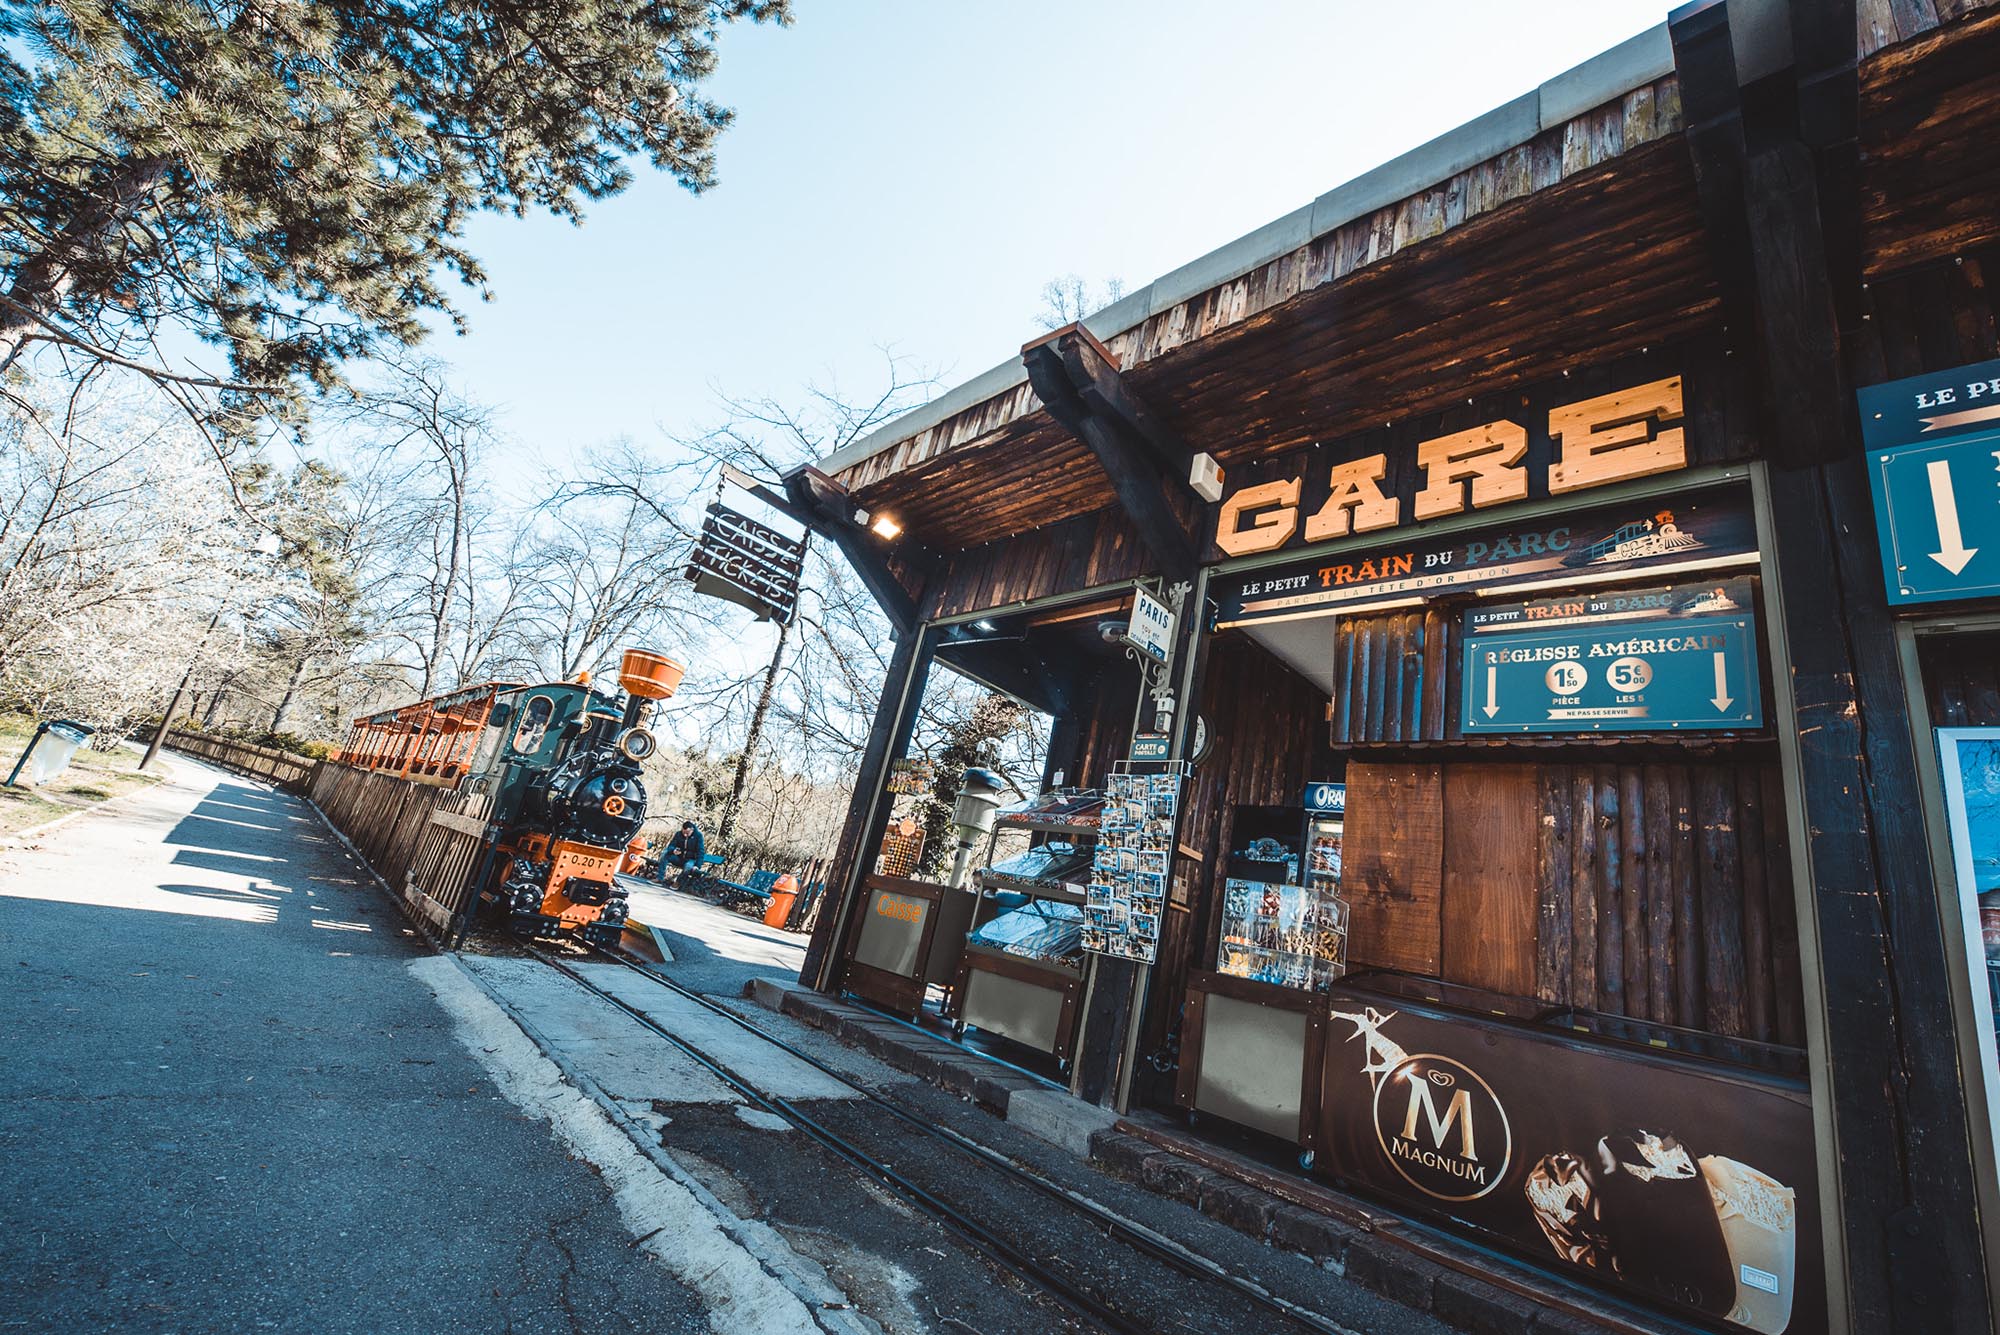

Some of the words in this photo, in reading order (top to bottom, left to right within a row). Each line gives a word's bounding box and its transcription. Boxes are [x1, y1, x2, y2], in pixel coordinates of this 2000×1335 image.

[1915, 388, 1956, 409] LE
[1216, 374, 1687, 557] GARE
[1241, 580, 1261, 597] LE
[1264, 574, 1310, 593] PETIT
[1317, 553, 1415, 587] TRAIN
[1425, 549, 1453, 569] DU
[1464, 527, 1571, 566] PARC
[1277, 595, 1310, 607] PARC
[1318, 592, 1334, 602] DE
[1343, 589, 1359, 598] LA
[1369, 581, 1406, 594] TÊTE
[1416, 575, 1456, 588] D'OR
[1466, 566, 1511, 580] LYON
[1139, 597, 1169, 629] PARIS
[1474, 615, 1487, 623] LE
[1489, 611, 1520, 621] PETIT
[1525, 602, 1585, 620] TRAIN
[1591, 603, 1608, 612] DU
[1614, 593, 1673, 611] PARC
[1485, 645, 1581, 665] RÉGLISSE
[1587, 633, 1728, 658] AMÉRICAIN
[1552, 695, 1581, 705] PIÈCE
[1616, 695, 1635, 703] LES
[1135, 743, 1158, 751] CARTE
[571, 854, 595, 868] 0.20
[597, 860, 604, 869] T
[877, 895, 922, 923] Caisse
[1401, 1073, 1479, 1162] M
